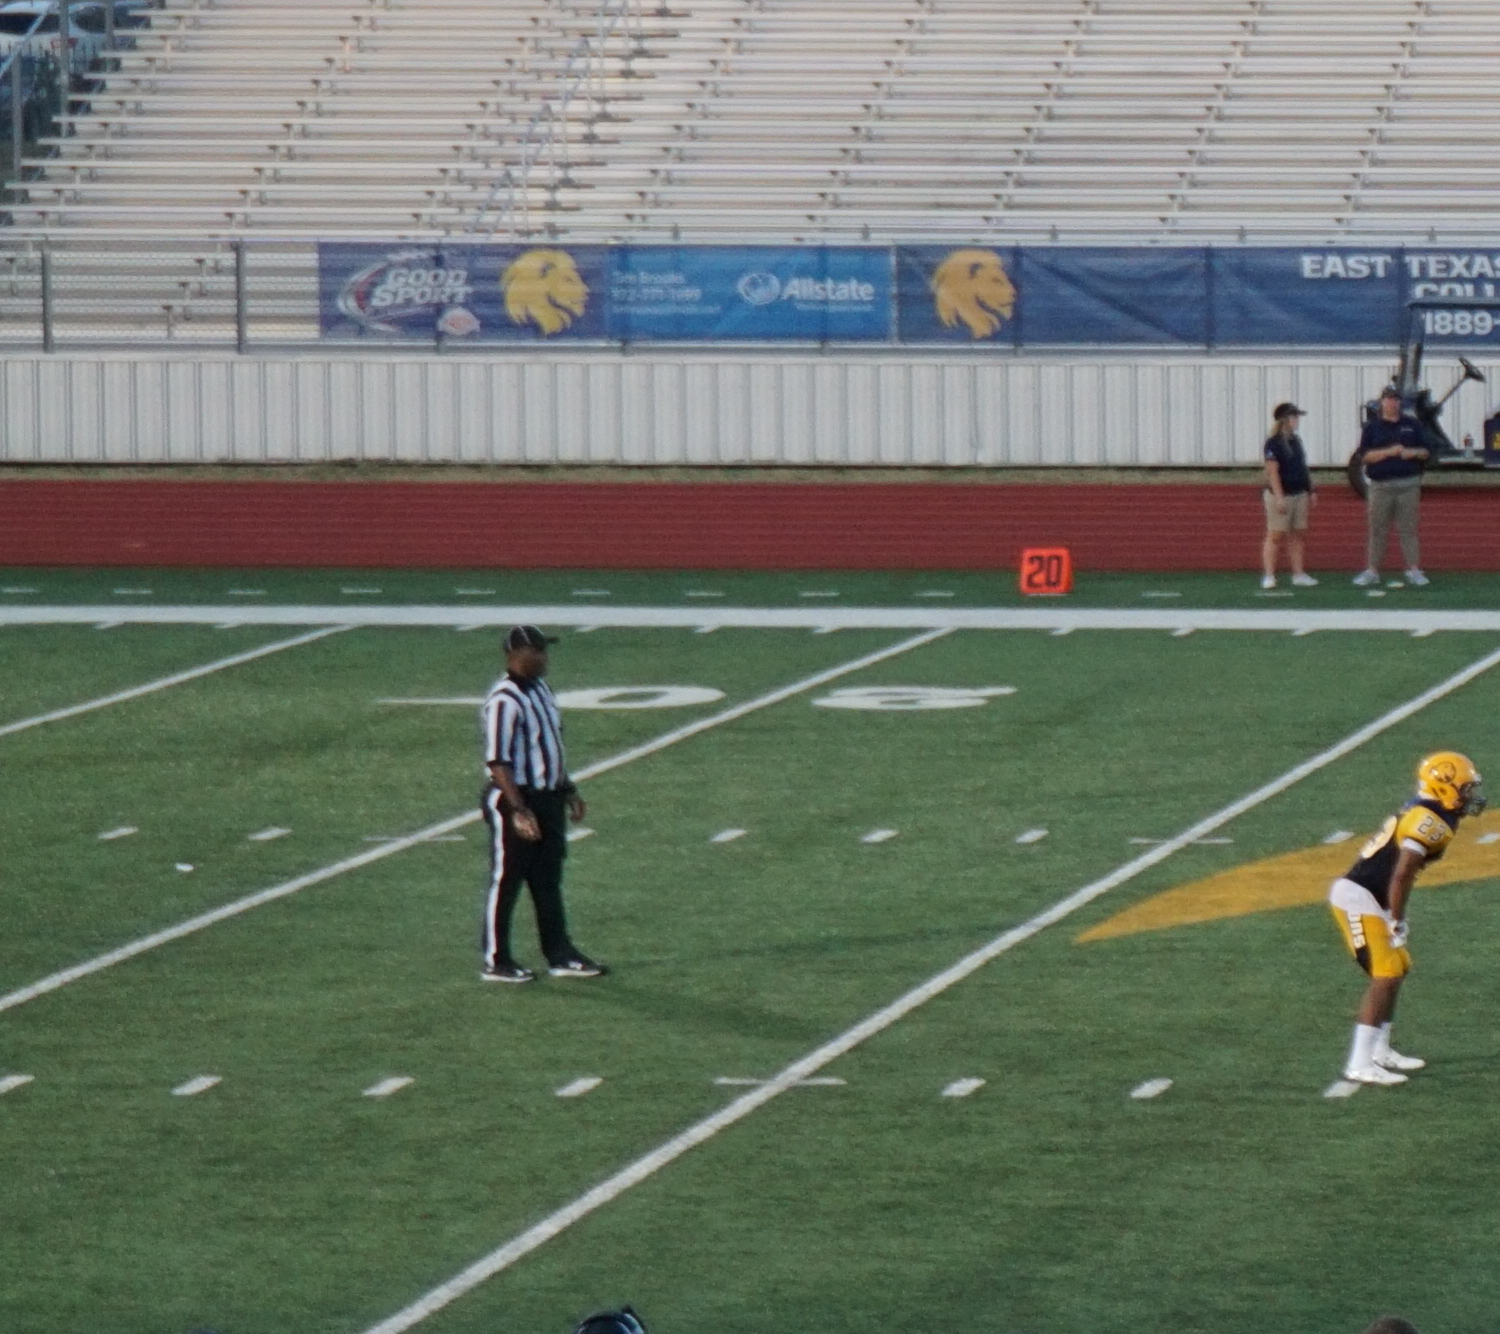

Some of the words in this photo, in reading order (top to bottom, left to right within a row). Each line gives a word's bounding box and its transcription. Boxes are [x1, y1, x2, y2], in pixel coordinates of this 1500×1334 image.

[387, 268, 468, 288] GOOD
[1300, 254, 1392, 280] EAST
[371, 286, 474, 307] SPORT
[781, 277, 875, 301] Allstate
[1026, 555, 1063, 589] 20
[1416, 814, 1447, 844] 23
